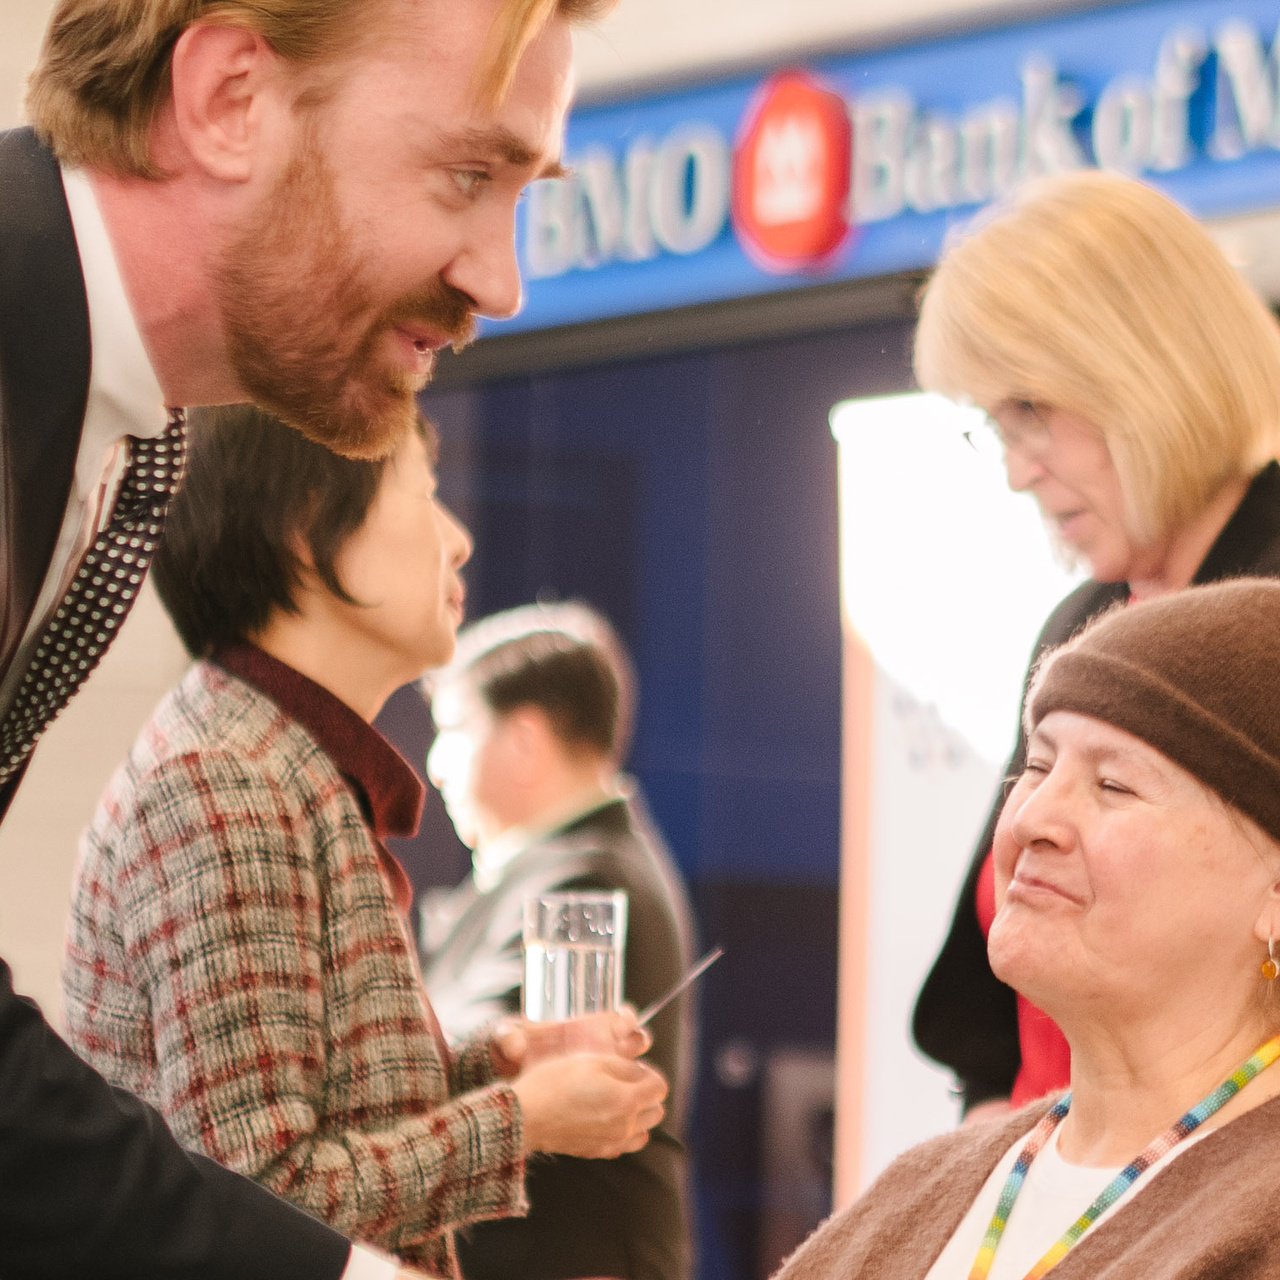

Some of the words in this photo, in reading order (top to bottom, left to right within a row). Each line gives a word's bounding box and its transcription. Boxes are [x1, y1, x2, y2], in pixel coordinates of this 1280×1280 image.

[527, 124, 729, 276] BMO
[850, 54, 1091, 221] Bank
[1092, 30, 1203, 171] of
